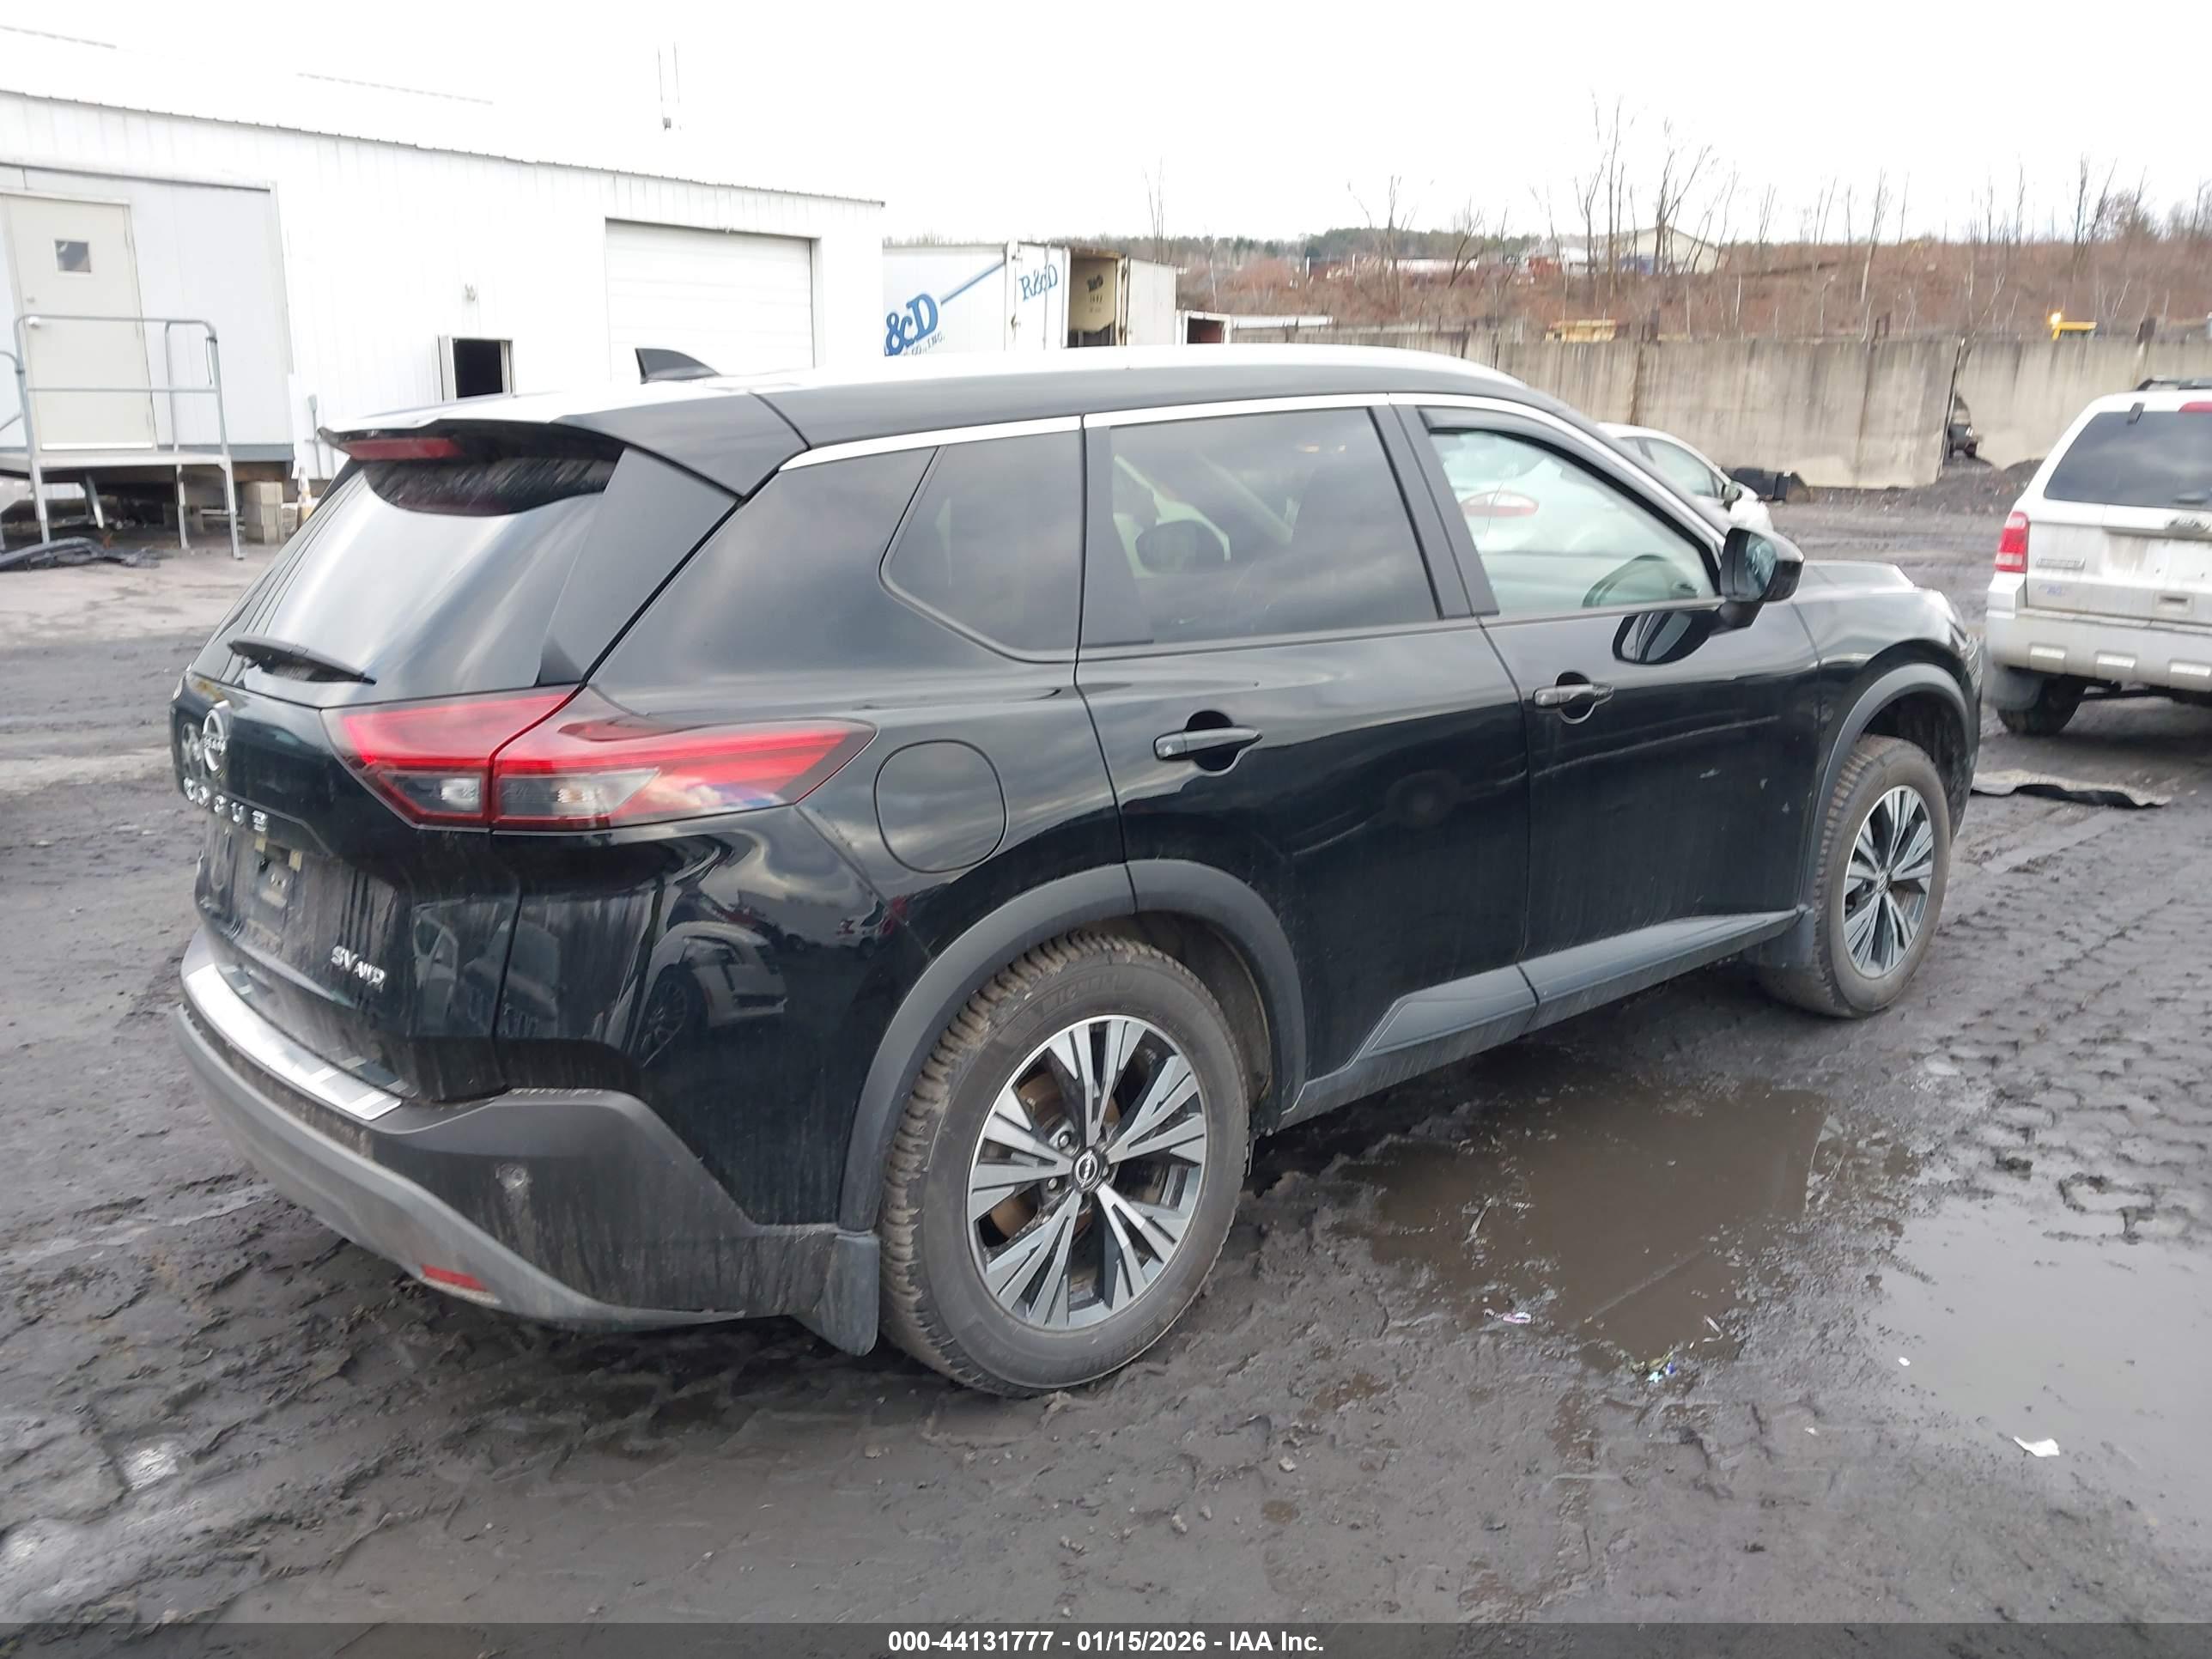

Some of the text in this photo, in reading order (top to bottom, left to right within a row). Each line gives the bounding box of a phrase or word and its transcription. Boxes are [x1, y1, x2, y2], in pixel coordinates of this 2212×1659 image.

[1018, 264, 1058, 301] R&D
[884, 293, 939, 356] &D
[331, 945, 359, 972] SV
